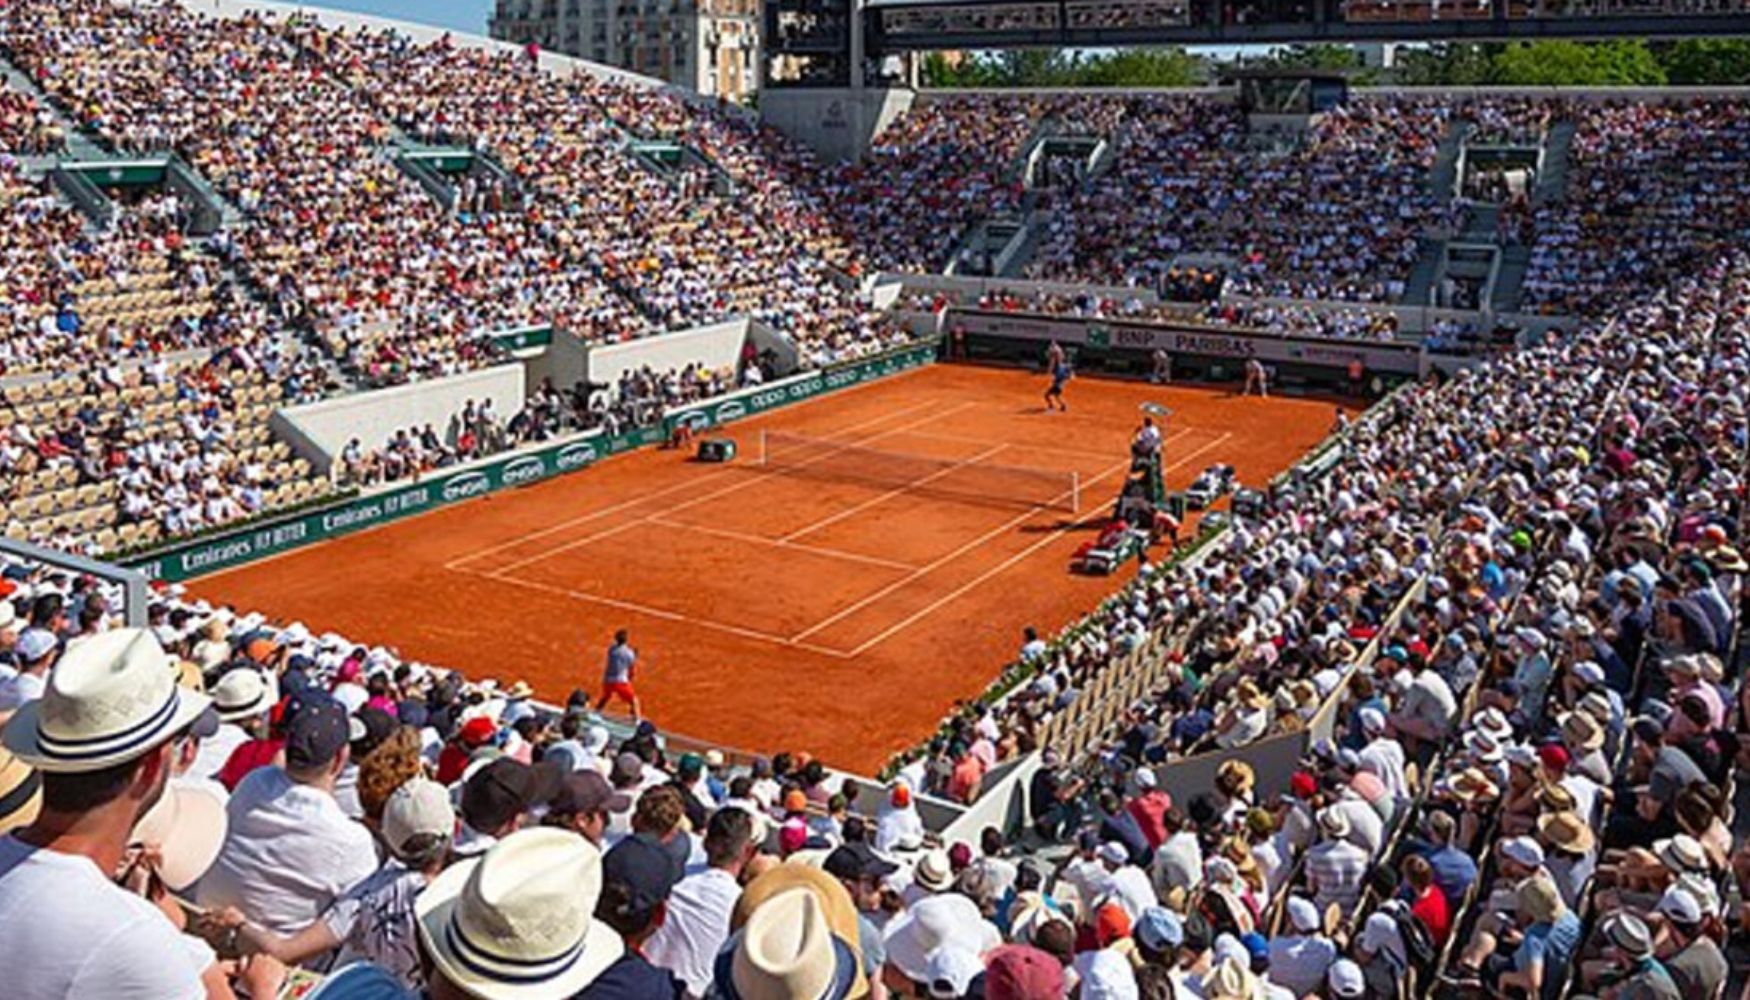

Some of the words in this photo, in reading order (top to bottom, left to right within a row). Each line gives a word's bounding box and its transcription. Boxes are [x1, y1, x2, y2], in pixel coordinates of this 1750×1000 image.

[1116, 329, 1155, 346] BNP
[1174, 335, 1257, 355] PARIBAS
[322, 504, 383, 532] Emirates
[181, 539, 252, 571] Emirates
